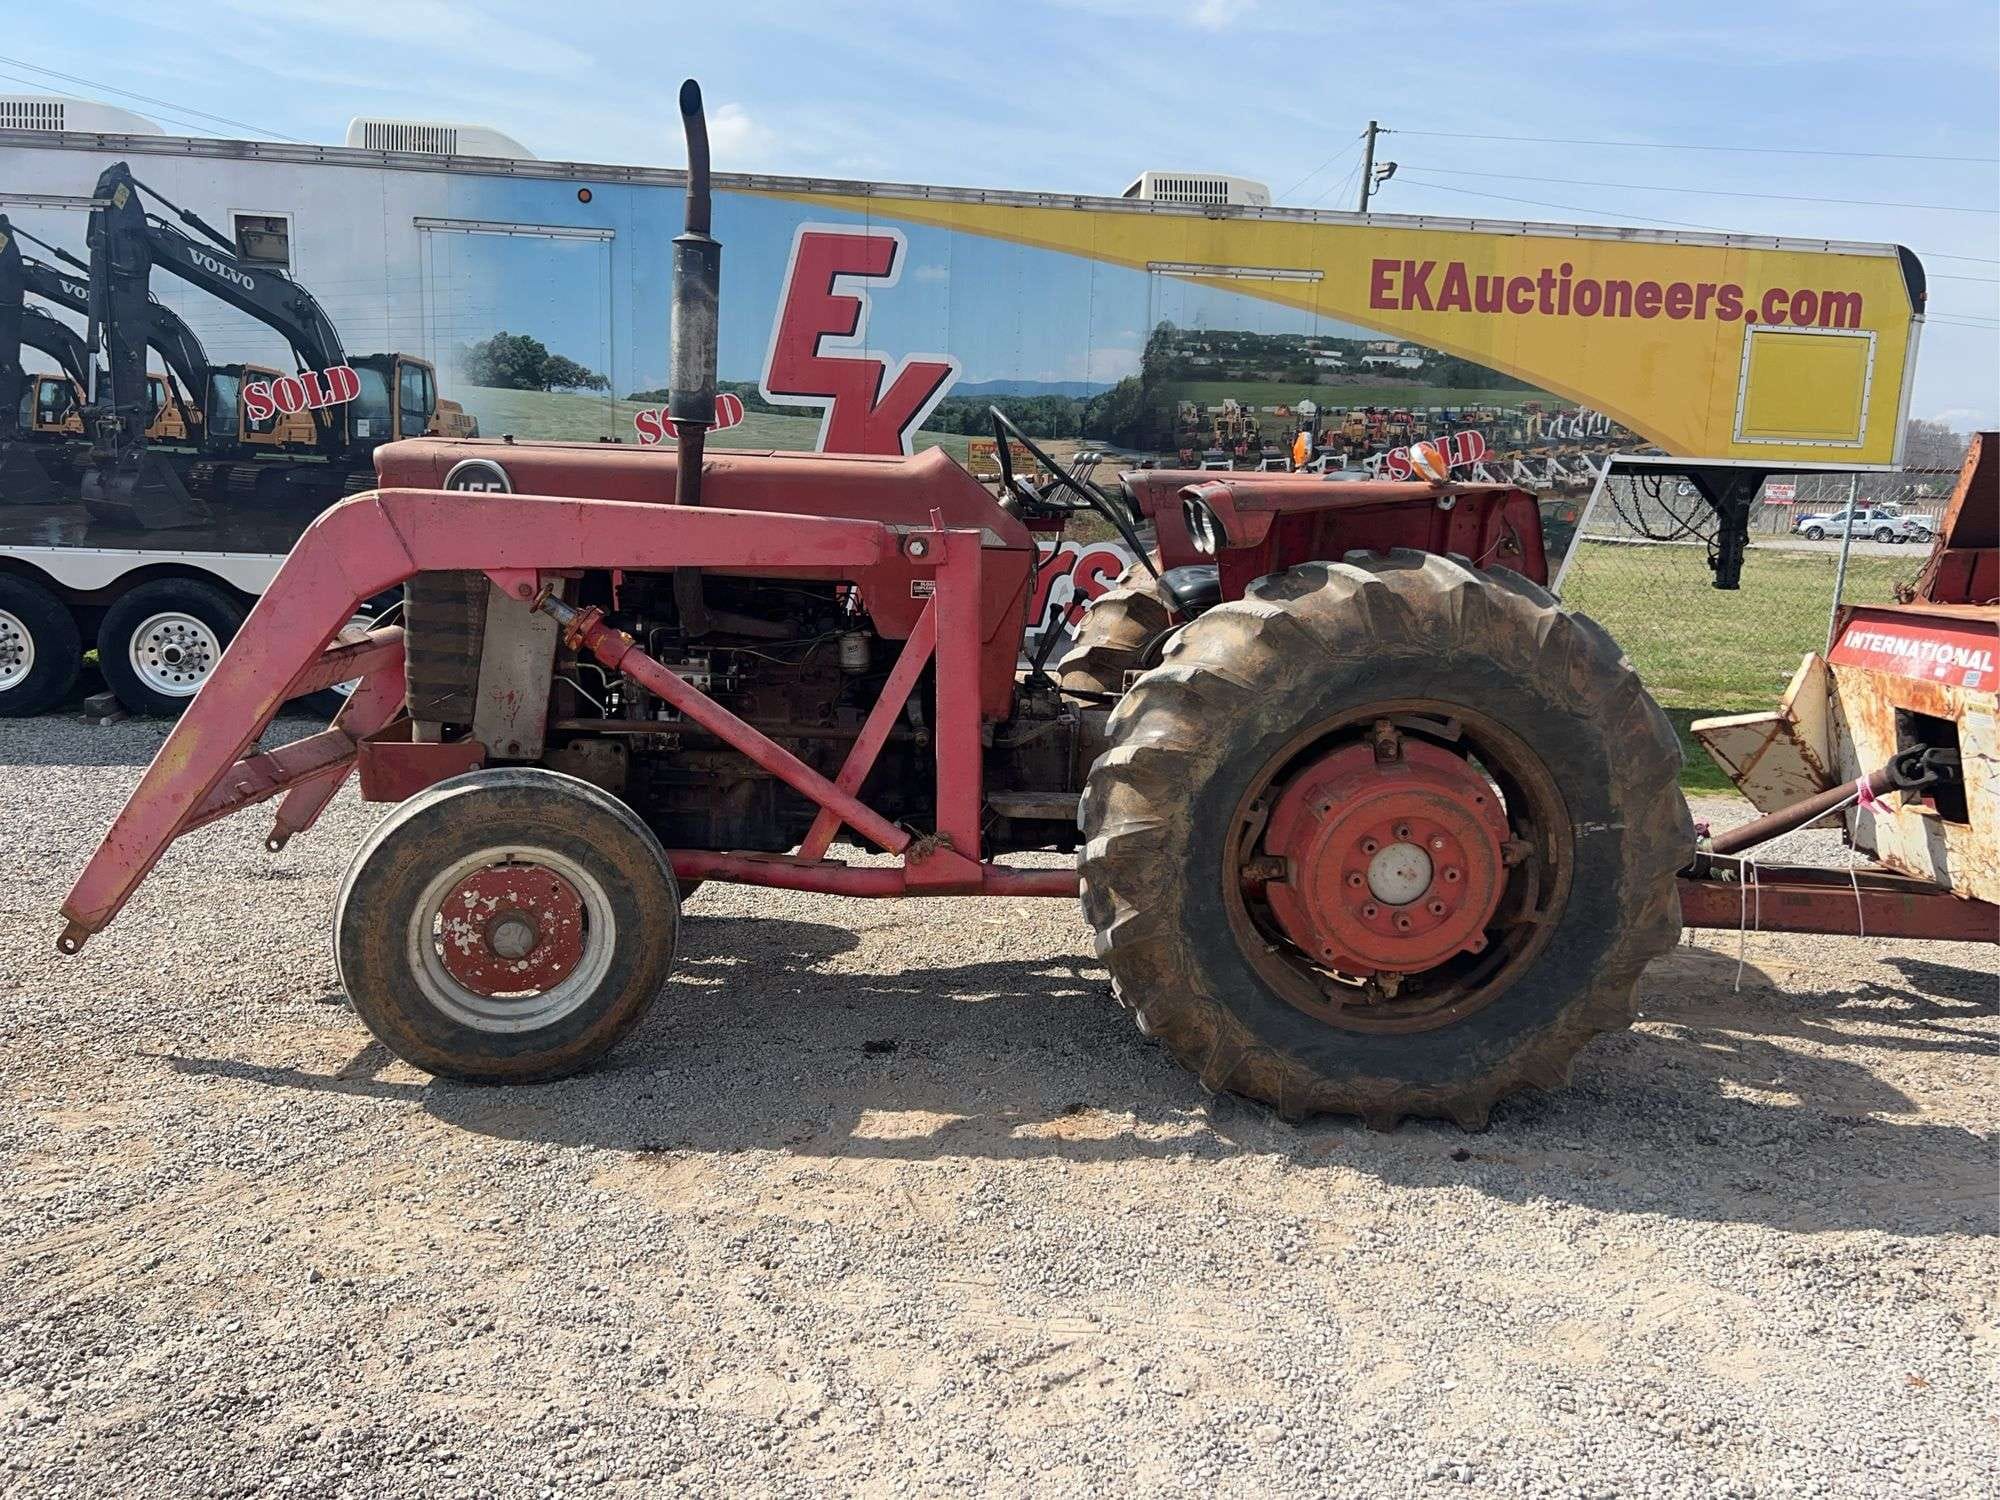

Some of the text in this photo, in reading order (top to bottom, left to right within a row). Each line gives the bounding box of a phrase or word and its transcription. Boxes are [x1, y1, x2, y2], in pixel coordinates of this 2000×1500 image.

[187, 246, 256, 291] VOLVO
[1369, 258, 1864, 329] EKAuctioneers.com
[759, 222, 962, 456] EK
[243, 365, 361, 421] SOLD
[1386, 429, 1486, 481] SLD
[1843, 630, 1994, 673] INTERNATIONAL
